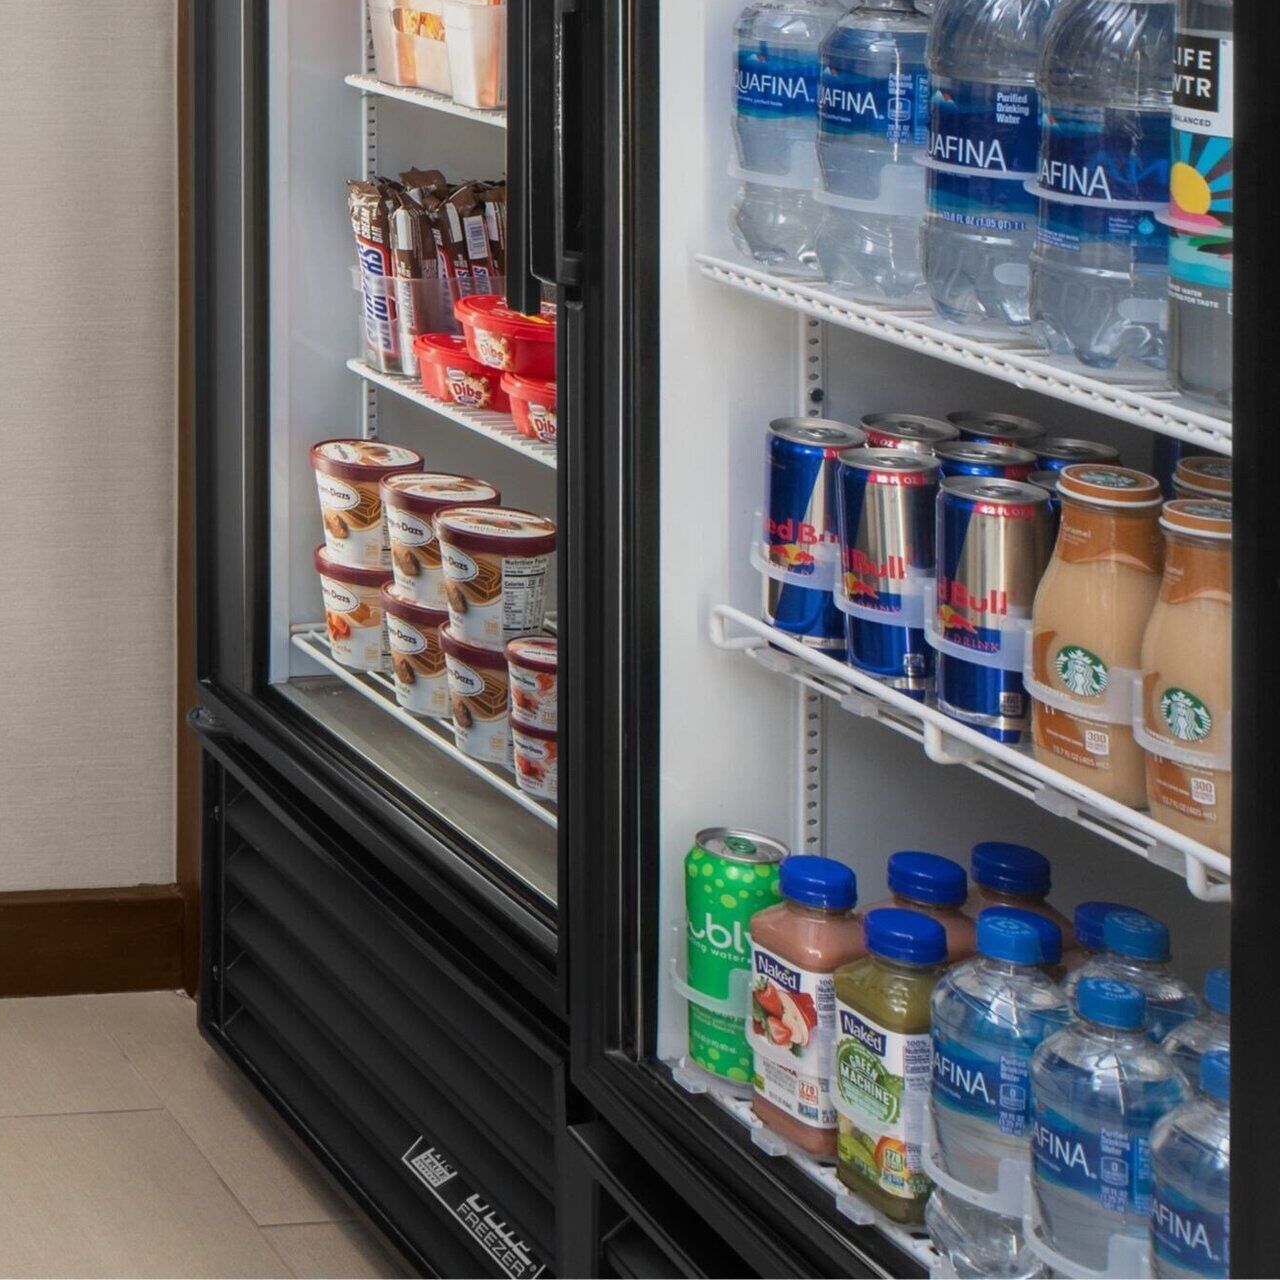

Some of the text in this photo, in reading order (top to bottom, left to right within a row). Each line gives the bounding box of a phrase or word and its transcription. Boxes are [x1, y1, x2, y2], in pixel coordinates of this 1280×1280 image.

[997, 92, 1028, 103] Purified
[997, 103, 1030, 115] Drinking
[997, 114, 1020, 124] Water
[1040, 159, 1111, 202] AFINA
[1197, 299, 1218, 308] TASTE
[480, 343, 504, 361] Dibs
[453, 382, 482, 400] Dibs
[904, 477, 919, 485] OZ
[997, 506, 1009, 515] FL
[505, 558, 533, 566] Nutrition
[851, 549, 906, 579] Bull
[950, 580, 1007, 615] Bull
[954, 637, 999, 652] DRINK
[1088, 732, 1107, 744] 300
[1193, 780, 1212, 792] 300
[758, 957, 797, 989] Naked
[844, 1016, 882, 1050] Naked
[849, 1054, 878, 1079] GREEN
[841, 1063, 890, 1106] MACHINE
[933, 1051, 989, 1104] AFINA
[1032, 1121, 1090, 1176] AFINA
[1151, 1199, 1213, 1259] AFINA
[456, 1202, 526, 1277] FREEZER
